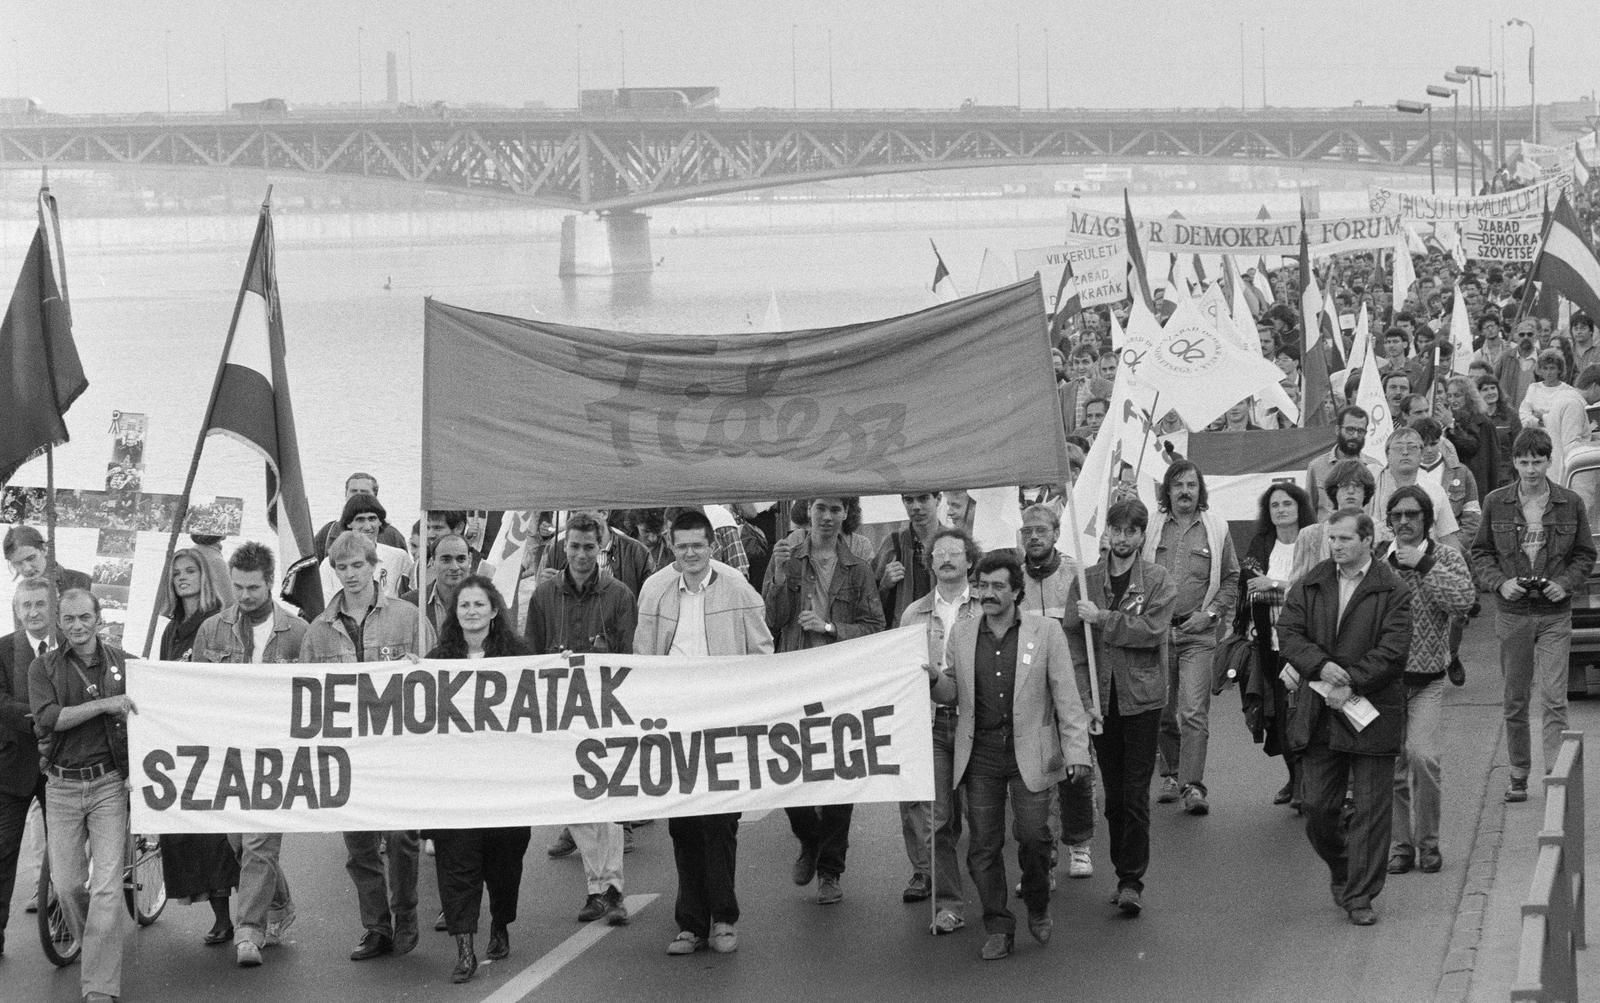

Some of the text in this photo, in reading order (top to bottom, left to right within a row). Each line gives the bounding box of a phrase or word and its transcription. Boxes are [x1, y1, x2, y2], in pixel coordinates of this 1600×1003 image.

[1070, 211, 1163, 243] MAGR
[1321, 214, 1402, 244] FÓRUM
[1478, 219, 1520, 233] SZABAD
[1073, 269, 1109, 285] ZABAD
[1049, 281, 1124, 306] DKRATÁK
[291, 655, 634, 739] DEMOKRATÁK
[142, 702, 901, 811] SZABAD SZÖVETSÉGE
